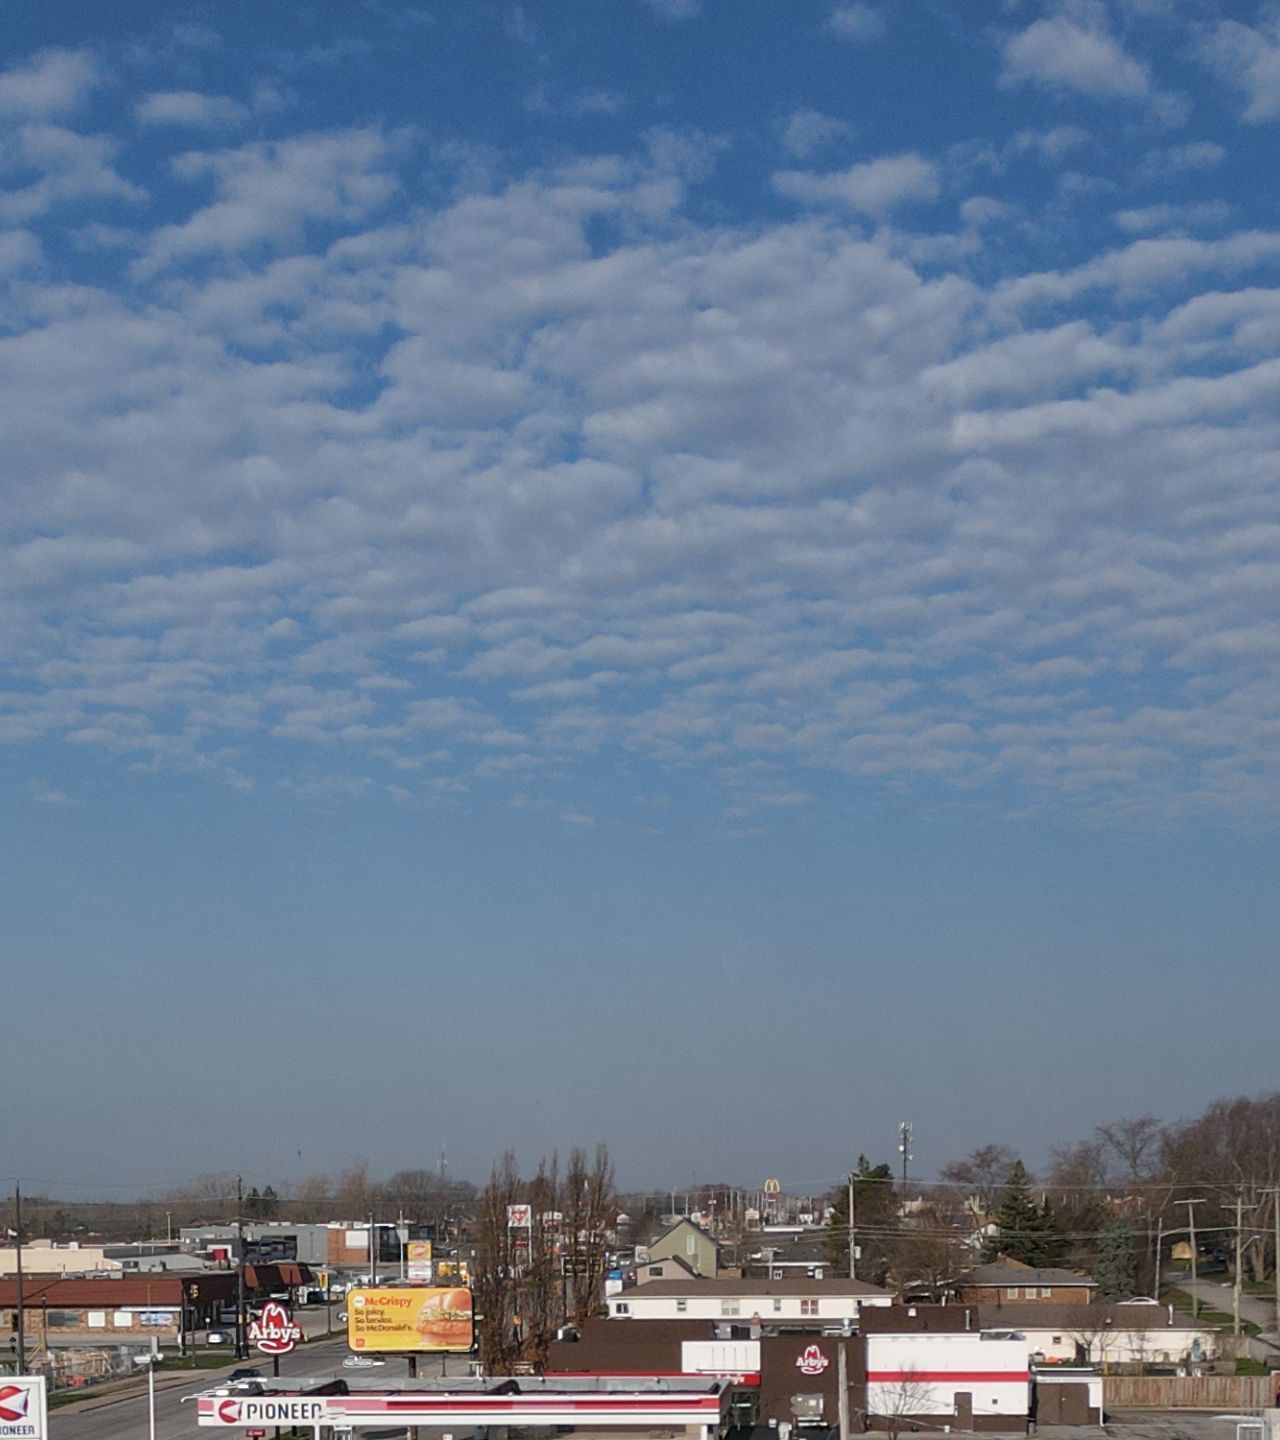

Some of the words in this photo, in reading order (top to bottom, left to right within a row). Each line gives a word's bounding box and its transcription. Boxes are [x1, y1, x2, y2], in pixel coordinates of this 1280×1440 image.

[365, 1296, 412, 1308] McCrispy
[249, 1322, 300, 1343] Arby's
[795, 1356, 829, 1369] Arby's
[246, 1403, 322, 1419] PIONEER
